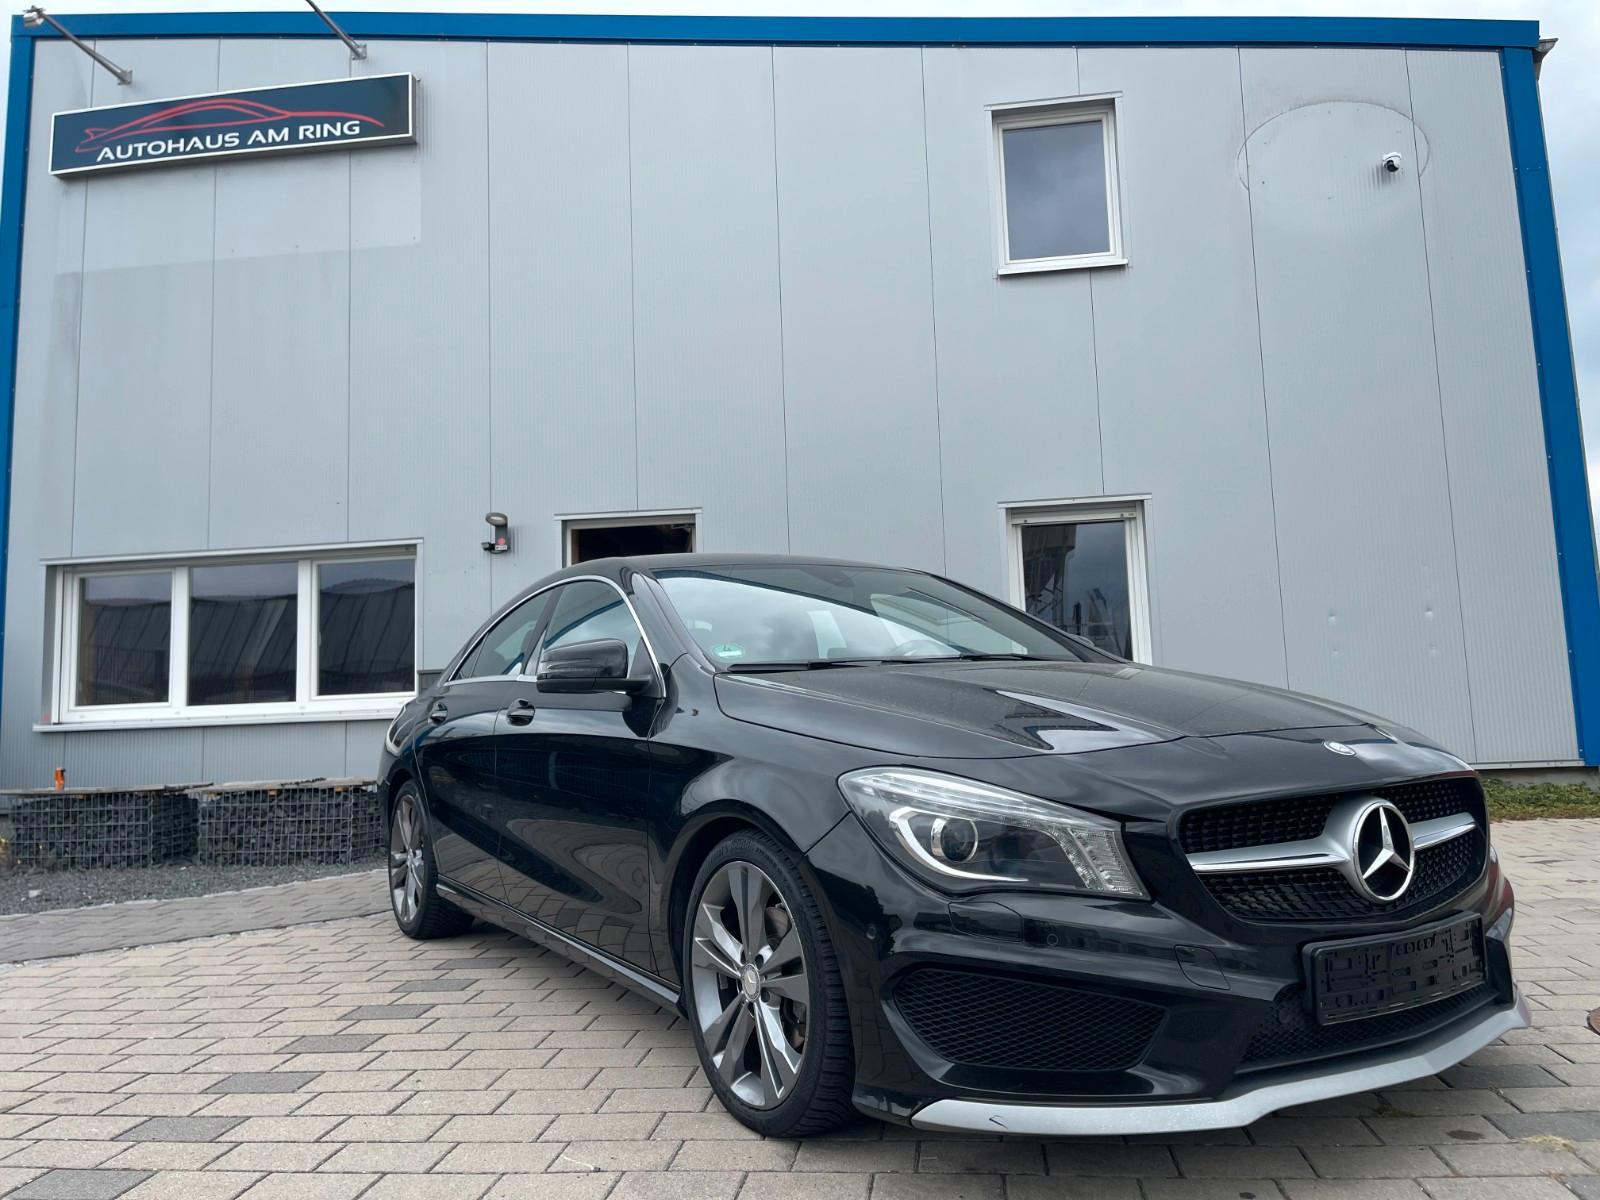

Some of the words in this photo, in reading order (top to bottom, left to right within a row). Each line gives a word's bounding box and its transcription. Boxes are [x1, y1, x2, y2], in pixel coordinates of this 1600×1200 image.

[96, 132, 240, 162] AUTOHAUS
[247, 127, 289, 145] AM
[298, 120, 360, 140] RING
